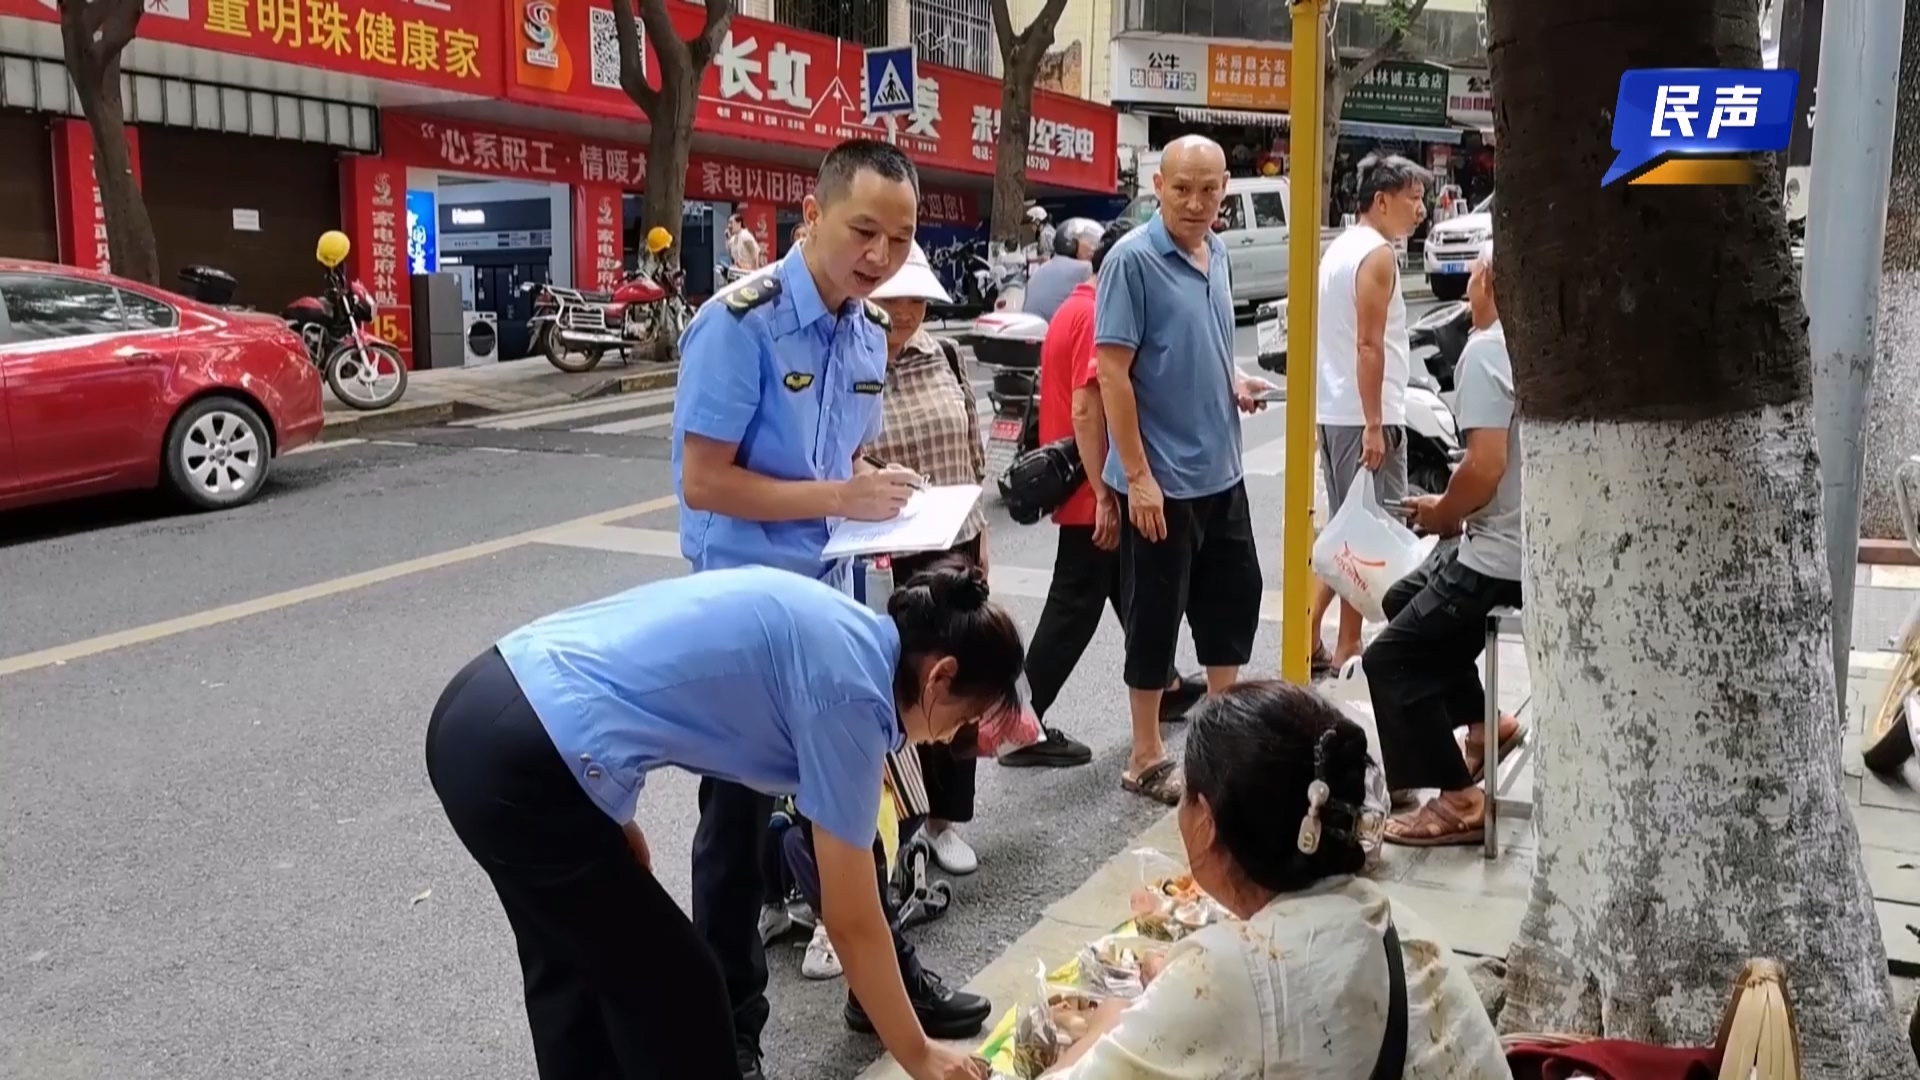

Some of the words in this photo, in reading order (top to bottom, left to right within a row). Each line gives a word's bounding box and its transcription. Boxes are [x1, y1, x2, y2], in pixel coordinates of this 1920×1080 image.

[714, 30, 812, 109] 长虹
[860, 67, 942, 138] 菱
[1148, 52, 1180, 71] 公牛
[372, 211, 397, 306] 家电政府补贴
